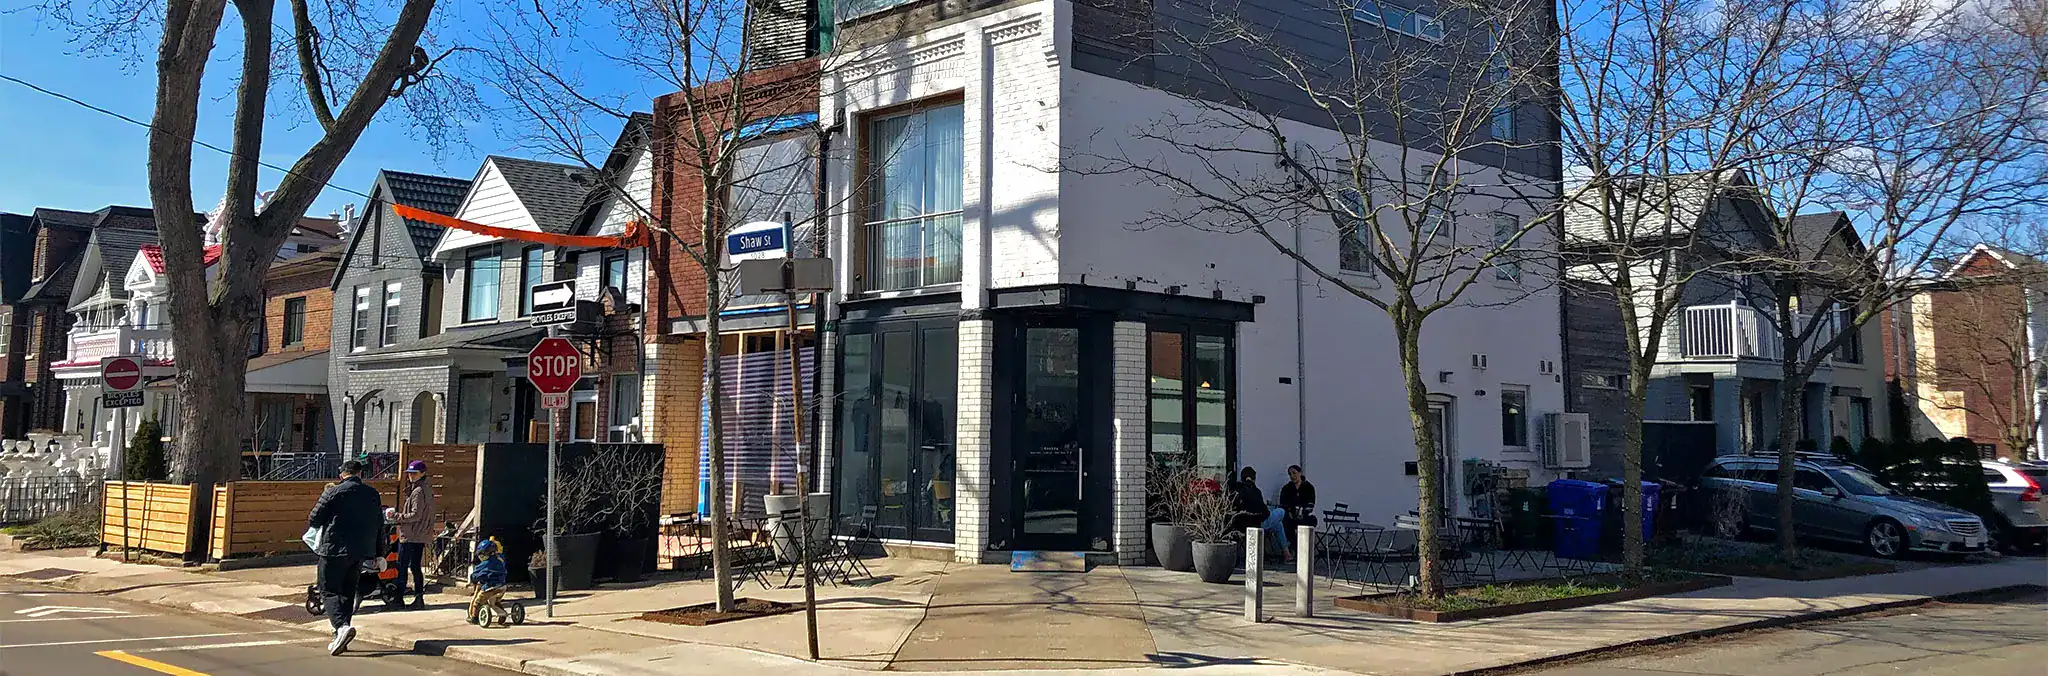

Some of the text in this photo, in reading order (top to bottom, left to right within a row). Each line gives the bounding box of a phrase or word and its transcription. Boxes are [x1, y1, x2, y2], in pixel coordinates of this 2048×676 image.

[740, 235, 771, 249] Shaw St
[532, 311, 575, 324] BICYCLES EXCEPTED
[532, 355, 578, 377] STOP
[107, 391, 139, 399] BICYCLES
[105, 398, 141, 406] EXCEPTED
[543, 396, 566, 407] ALL-WAY
